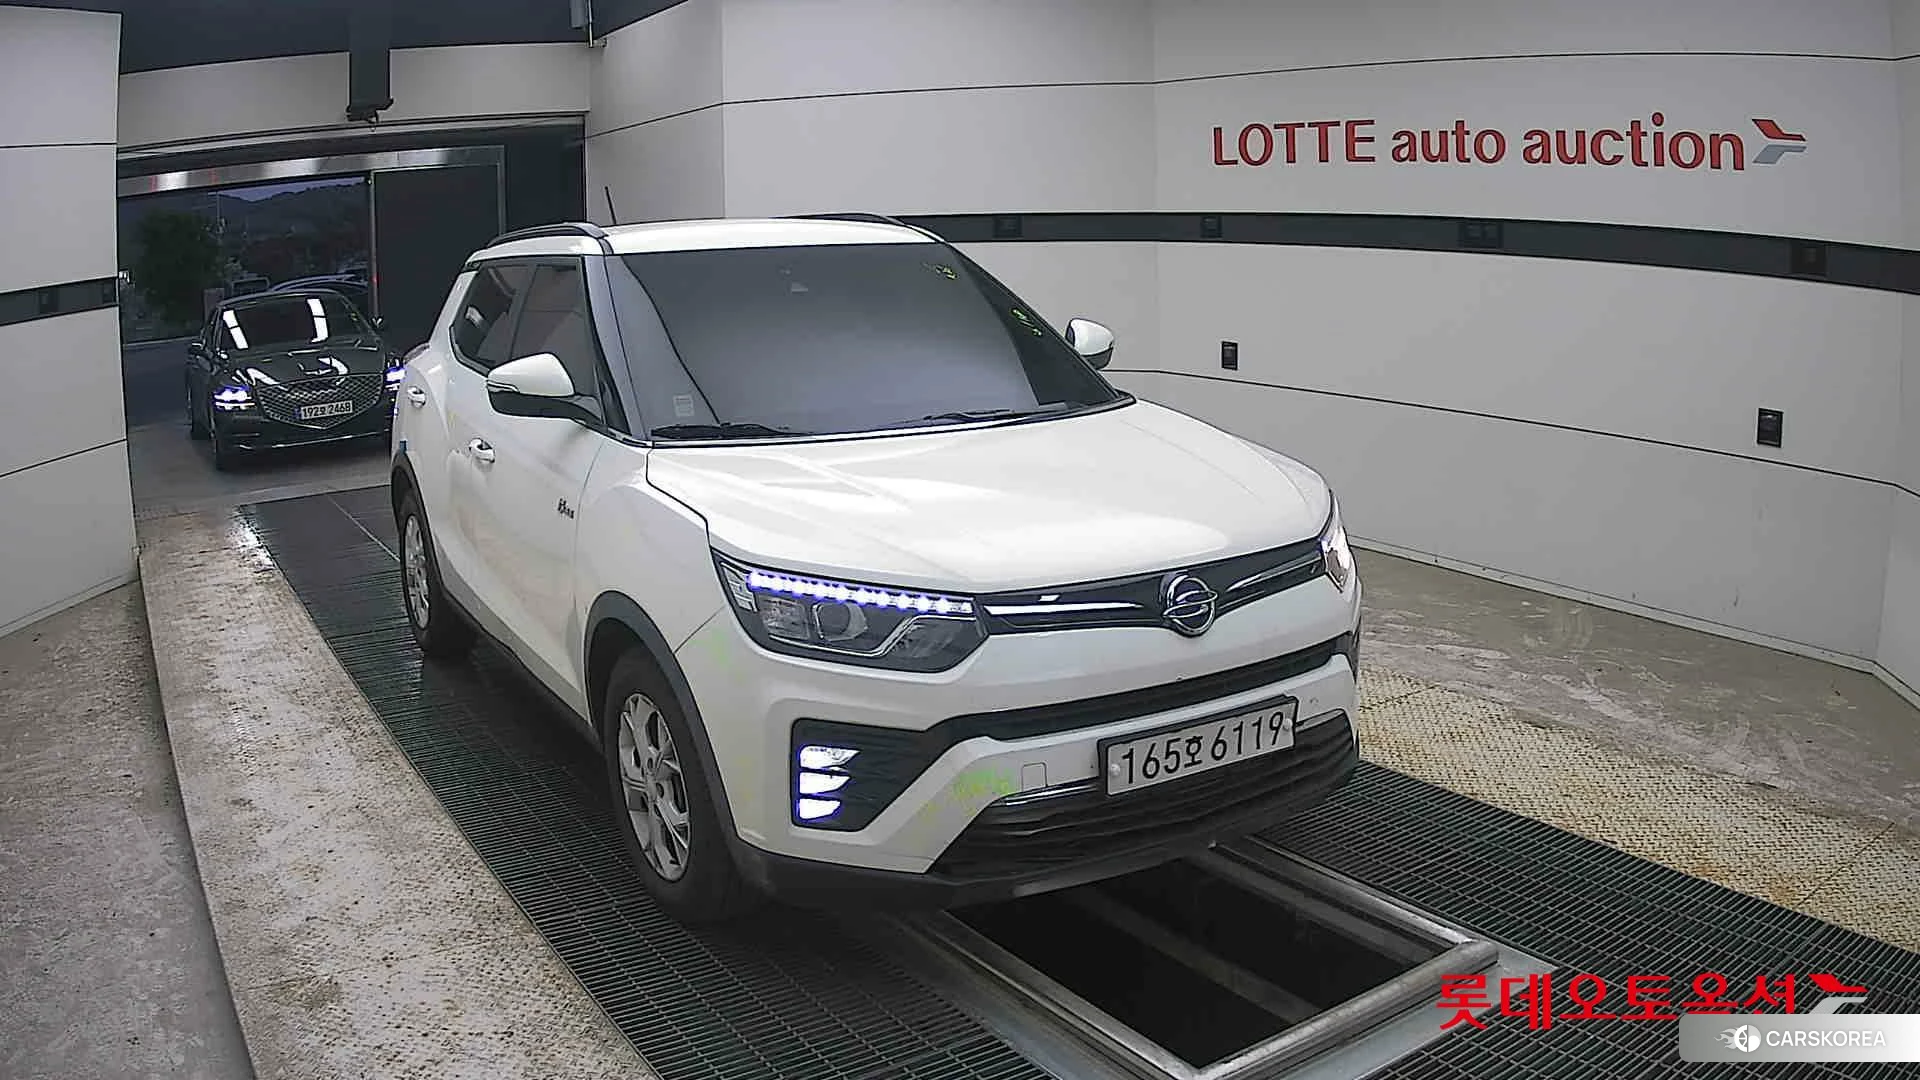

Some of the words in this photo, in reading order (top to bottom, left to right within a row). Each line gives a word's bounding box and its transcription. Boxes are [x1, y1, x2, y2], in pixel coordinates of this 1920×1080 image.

[1213, 119, 1376, 166] LOTTE
[1391, 120, 1506, 164] auto
[1522, 112, 1744, 171] auction
[1121, 735, 1204, 784] 165호
[1211, 711, 1284, 761] 6119
